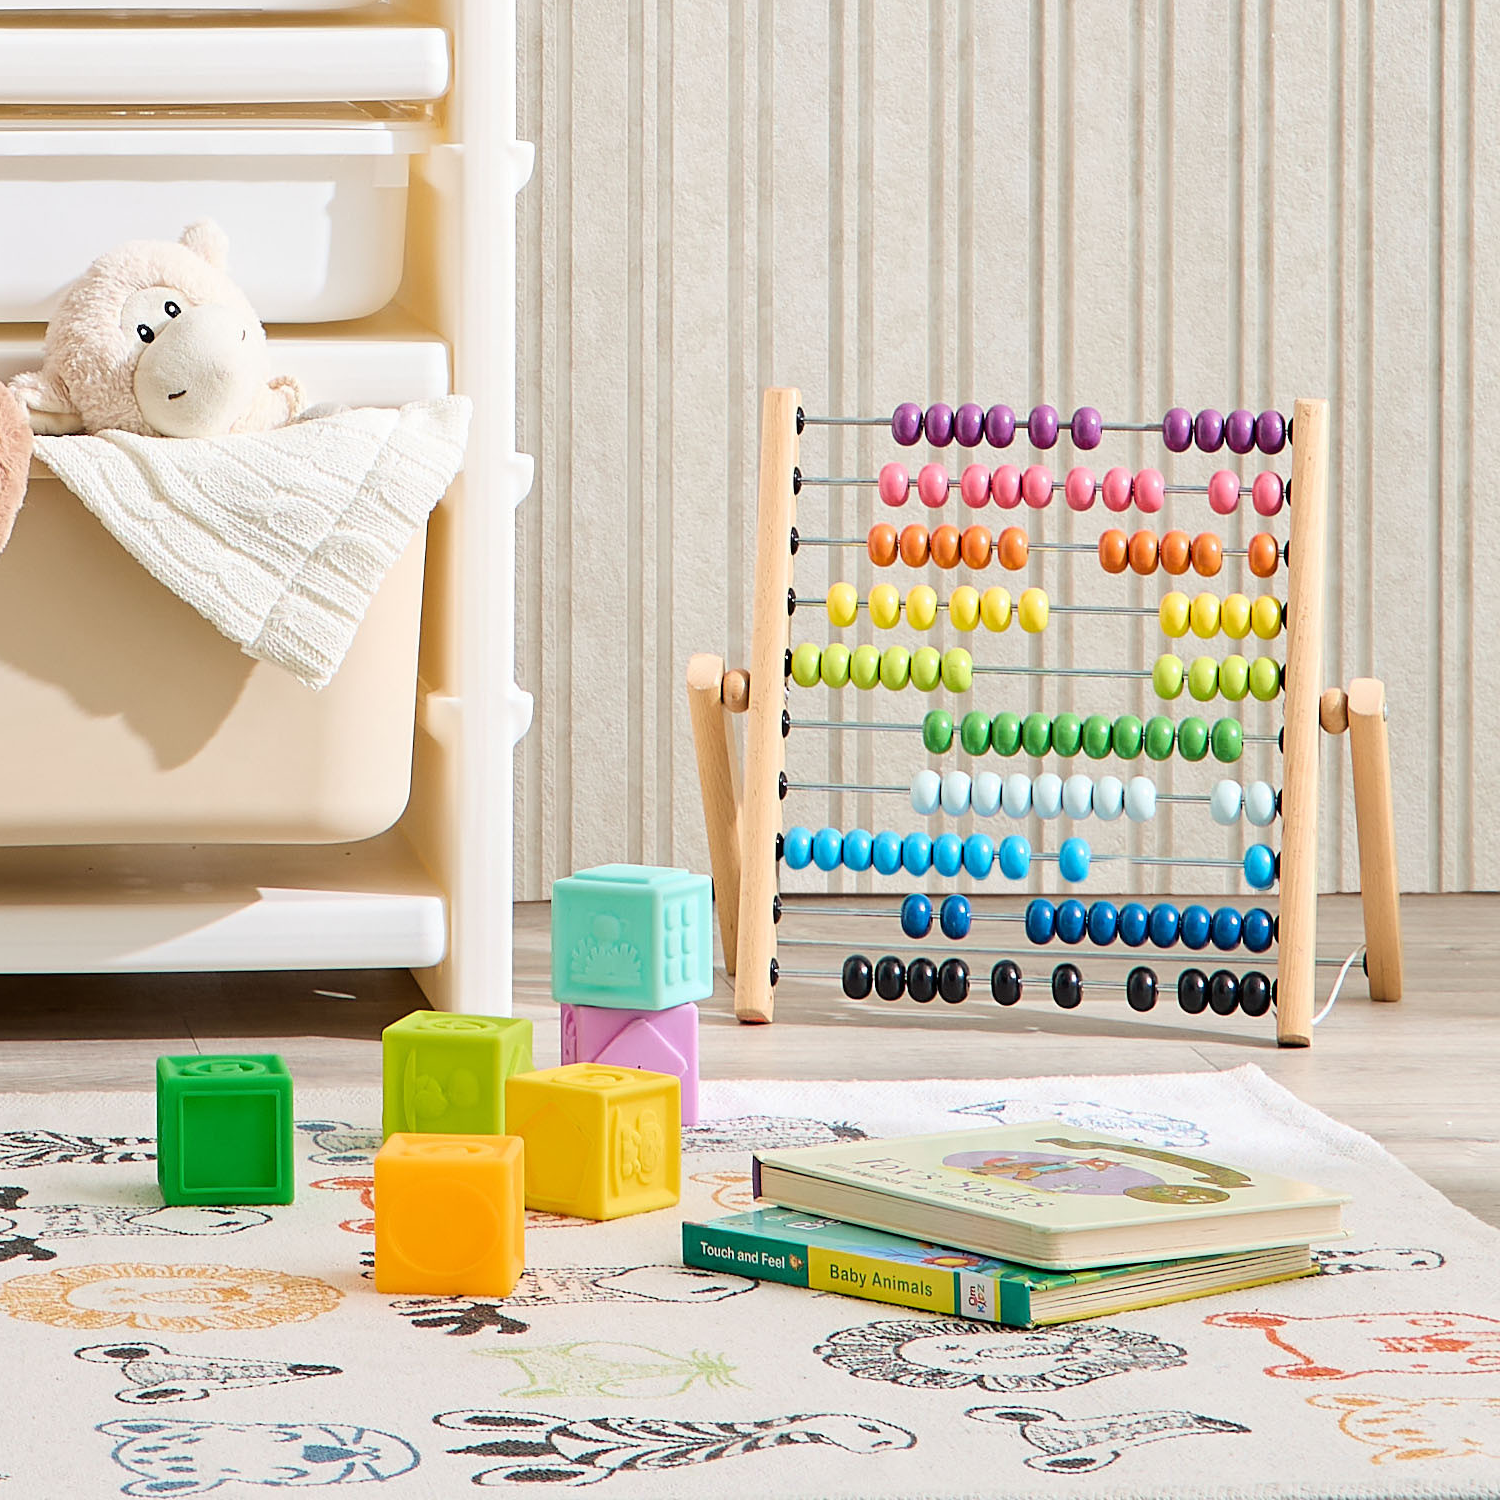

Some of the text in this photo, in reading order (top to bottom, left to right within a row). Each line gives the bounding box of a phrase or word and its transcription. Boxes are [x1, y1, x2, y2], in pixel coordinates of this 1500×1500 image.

[940, 1180, 1055, 1207] Socks
[700, 1241, 785, 1269] Touch and Feel
[829, 1263, 933, 1297] Baby Animals
